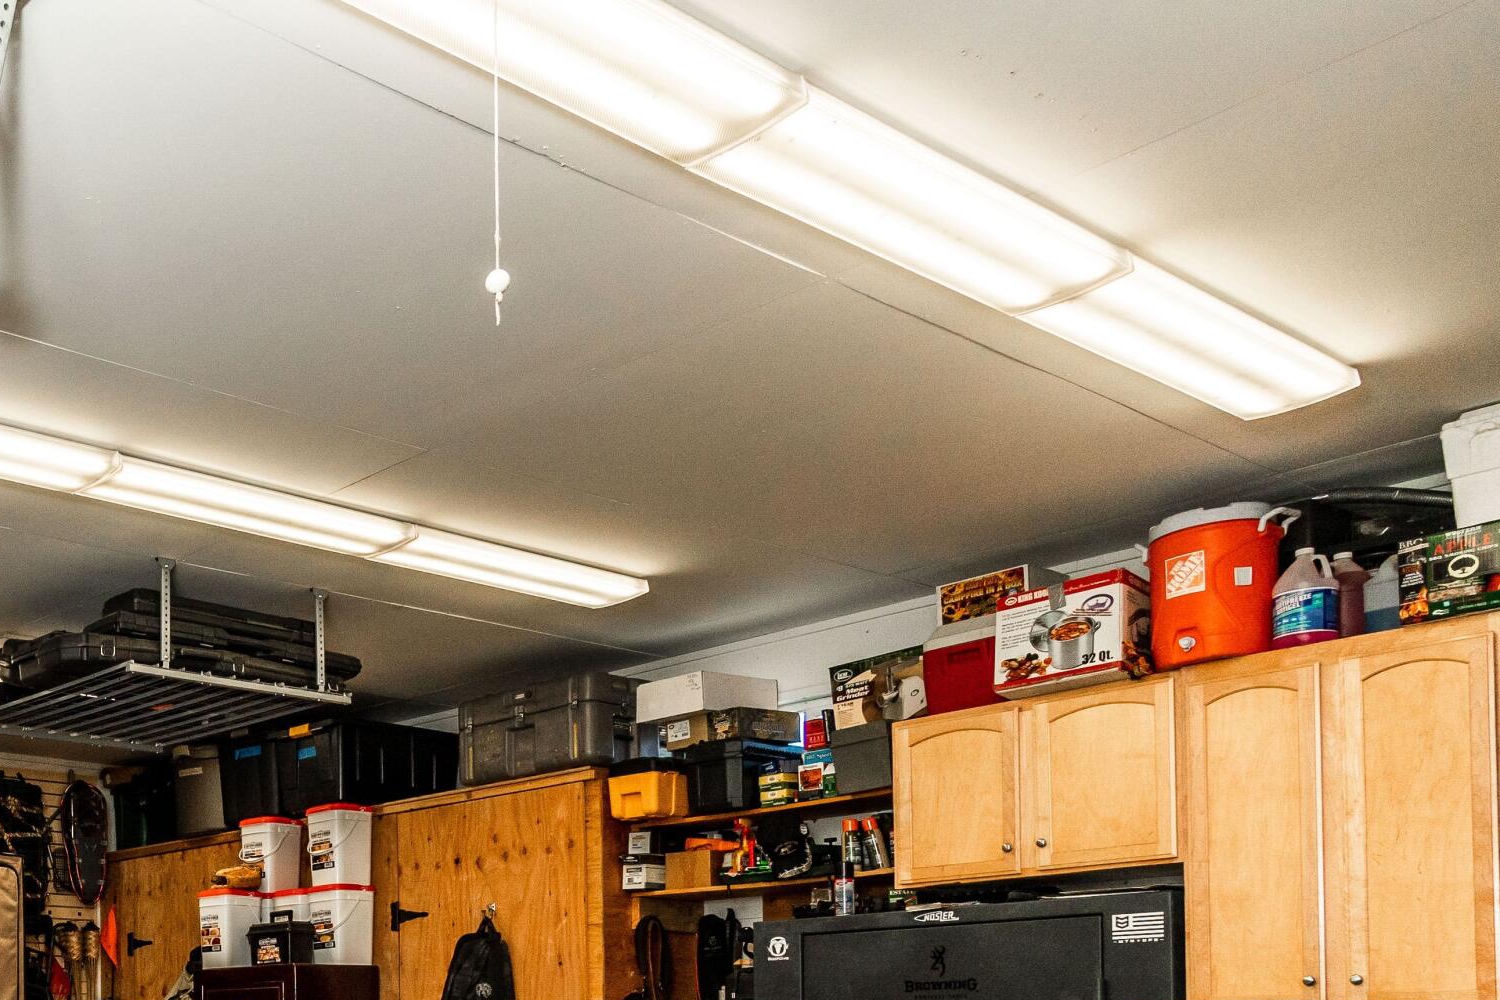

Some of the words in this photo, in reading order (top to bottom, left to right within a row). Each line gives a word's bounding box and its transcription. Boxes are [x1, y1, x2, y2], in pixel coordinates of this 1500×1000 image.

[1017, 592, 1033, 603] KING
[1081, 653, 1097, 665] 32
[845, 685, 870, 695] Meat
[836, 690, 871, 702] Grinder
[924, 911, 955, 921] NOSLER
[904, 979, 979, 993] BROWNING
